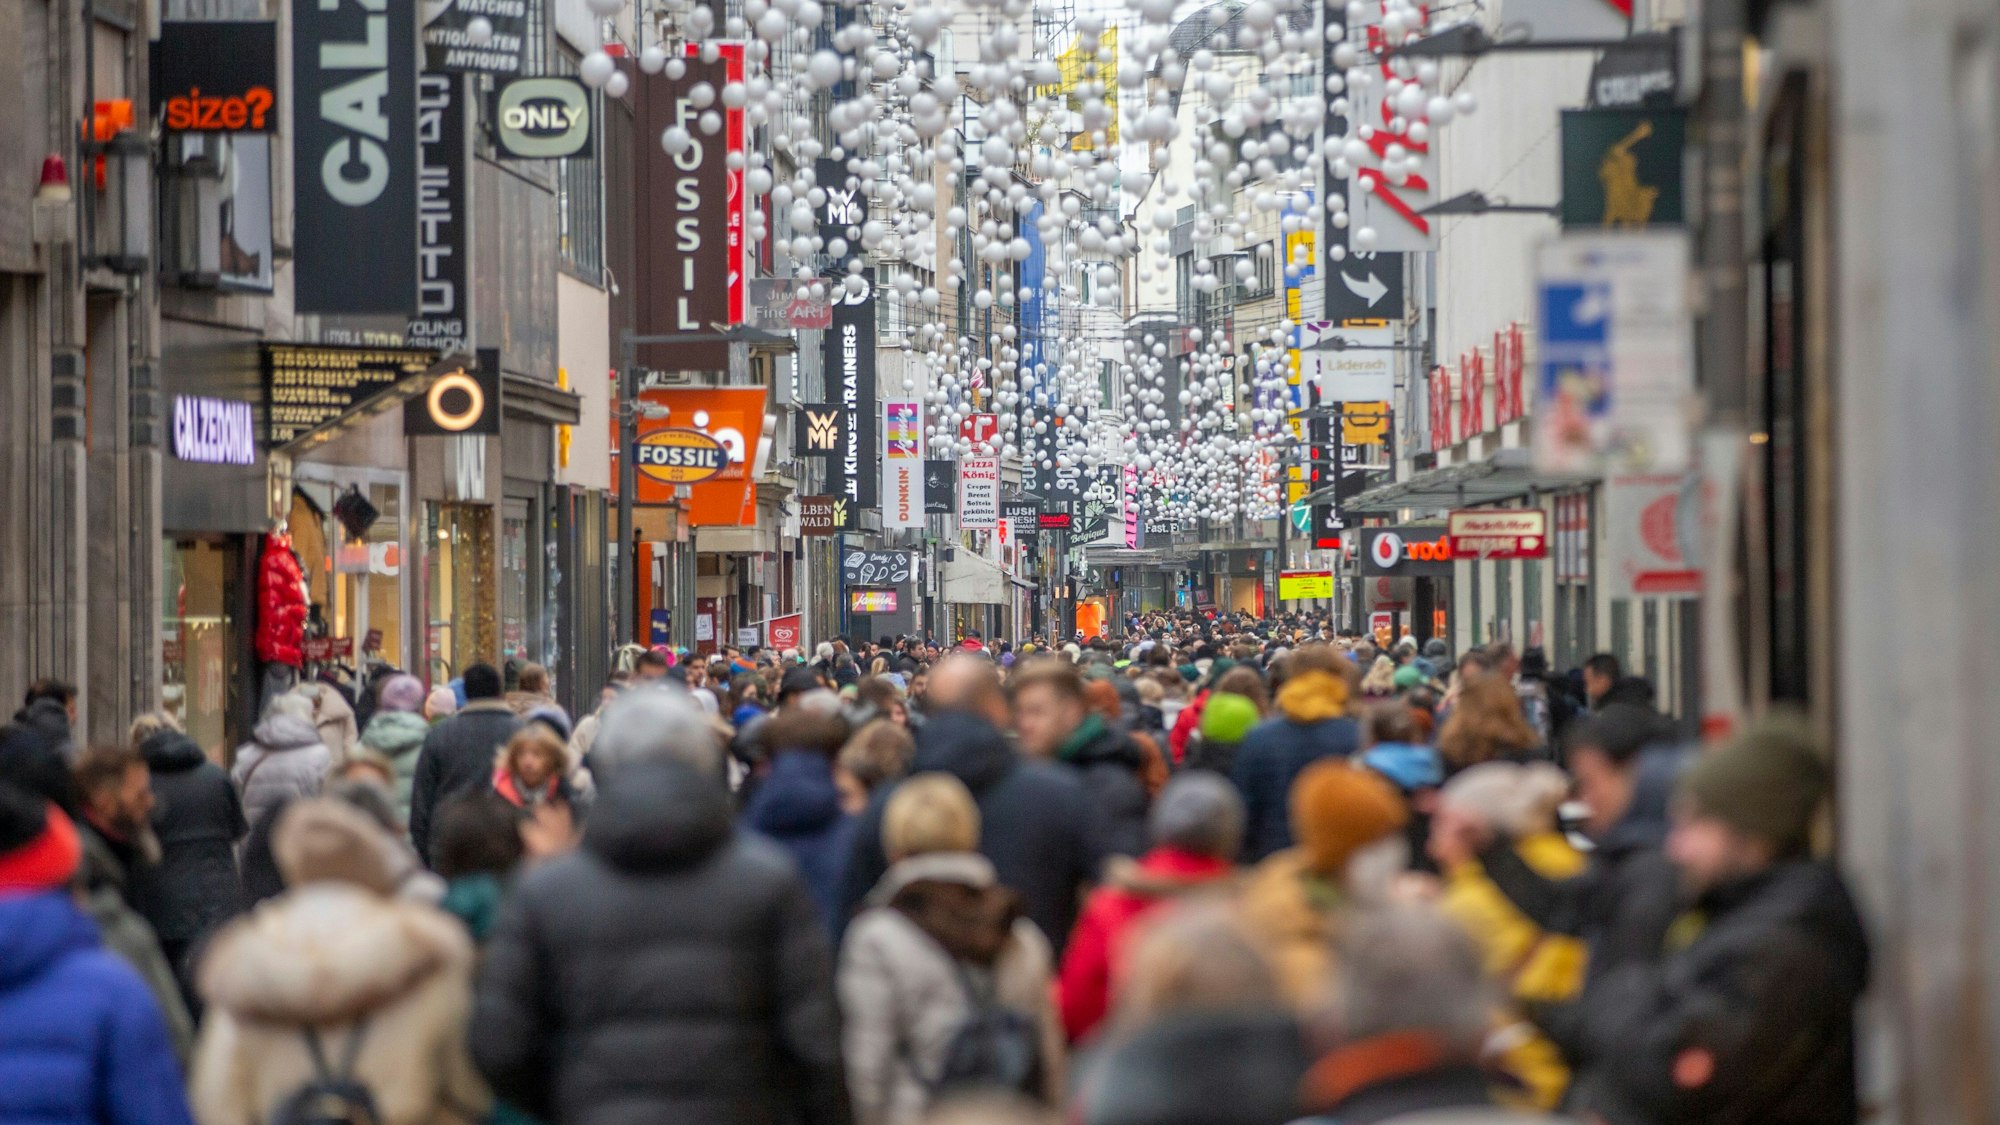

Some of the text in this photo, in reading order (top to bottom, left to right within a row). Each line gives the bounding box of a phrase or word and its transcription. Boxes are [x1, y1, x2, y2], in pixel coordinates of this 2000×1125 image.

[457, 0, 525, 17] WATCHES
[446, 50, 518, 71] ANTIQUES
[167, 85, 273, 129] size?
[319, 0, 390, 207] CAL
[503, 104, 582, 130] ONLY
[672, 98, 704, 330] FOSSIL
[754, 305, 827, 320] Fine ART
[1327, 359, 1387, 371] Läderach
[174, 395, 255, 465] CALZEDONIA
[806, 410, 839, 449] WMF
[639, 446, 718, 468] FOSSIL
[962, 470, 996, 480] König
[898, 466, 910, 522] DUNKIN'
[1006, 507, 1036, 516] LUSH
[1009, 516, 1036, 524] RESH
[1070, 528, 1106, 544] Belgique
[1145, 523, 1168, 533] Fast.
[1407, 535, 1451, 561] vod
[870, 553, 892, 564] Candy!
[852, 594, 897, 608] jamin
